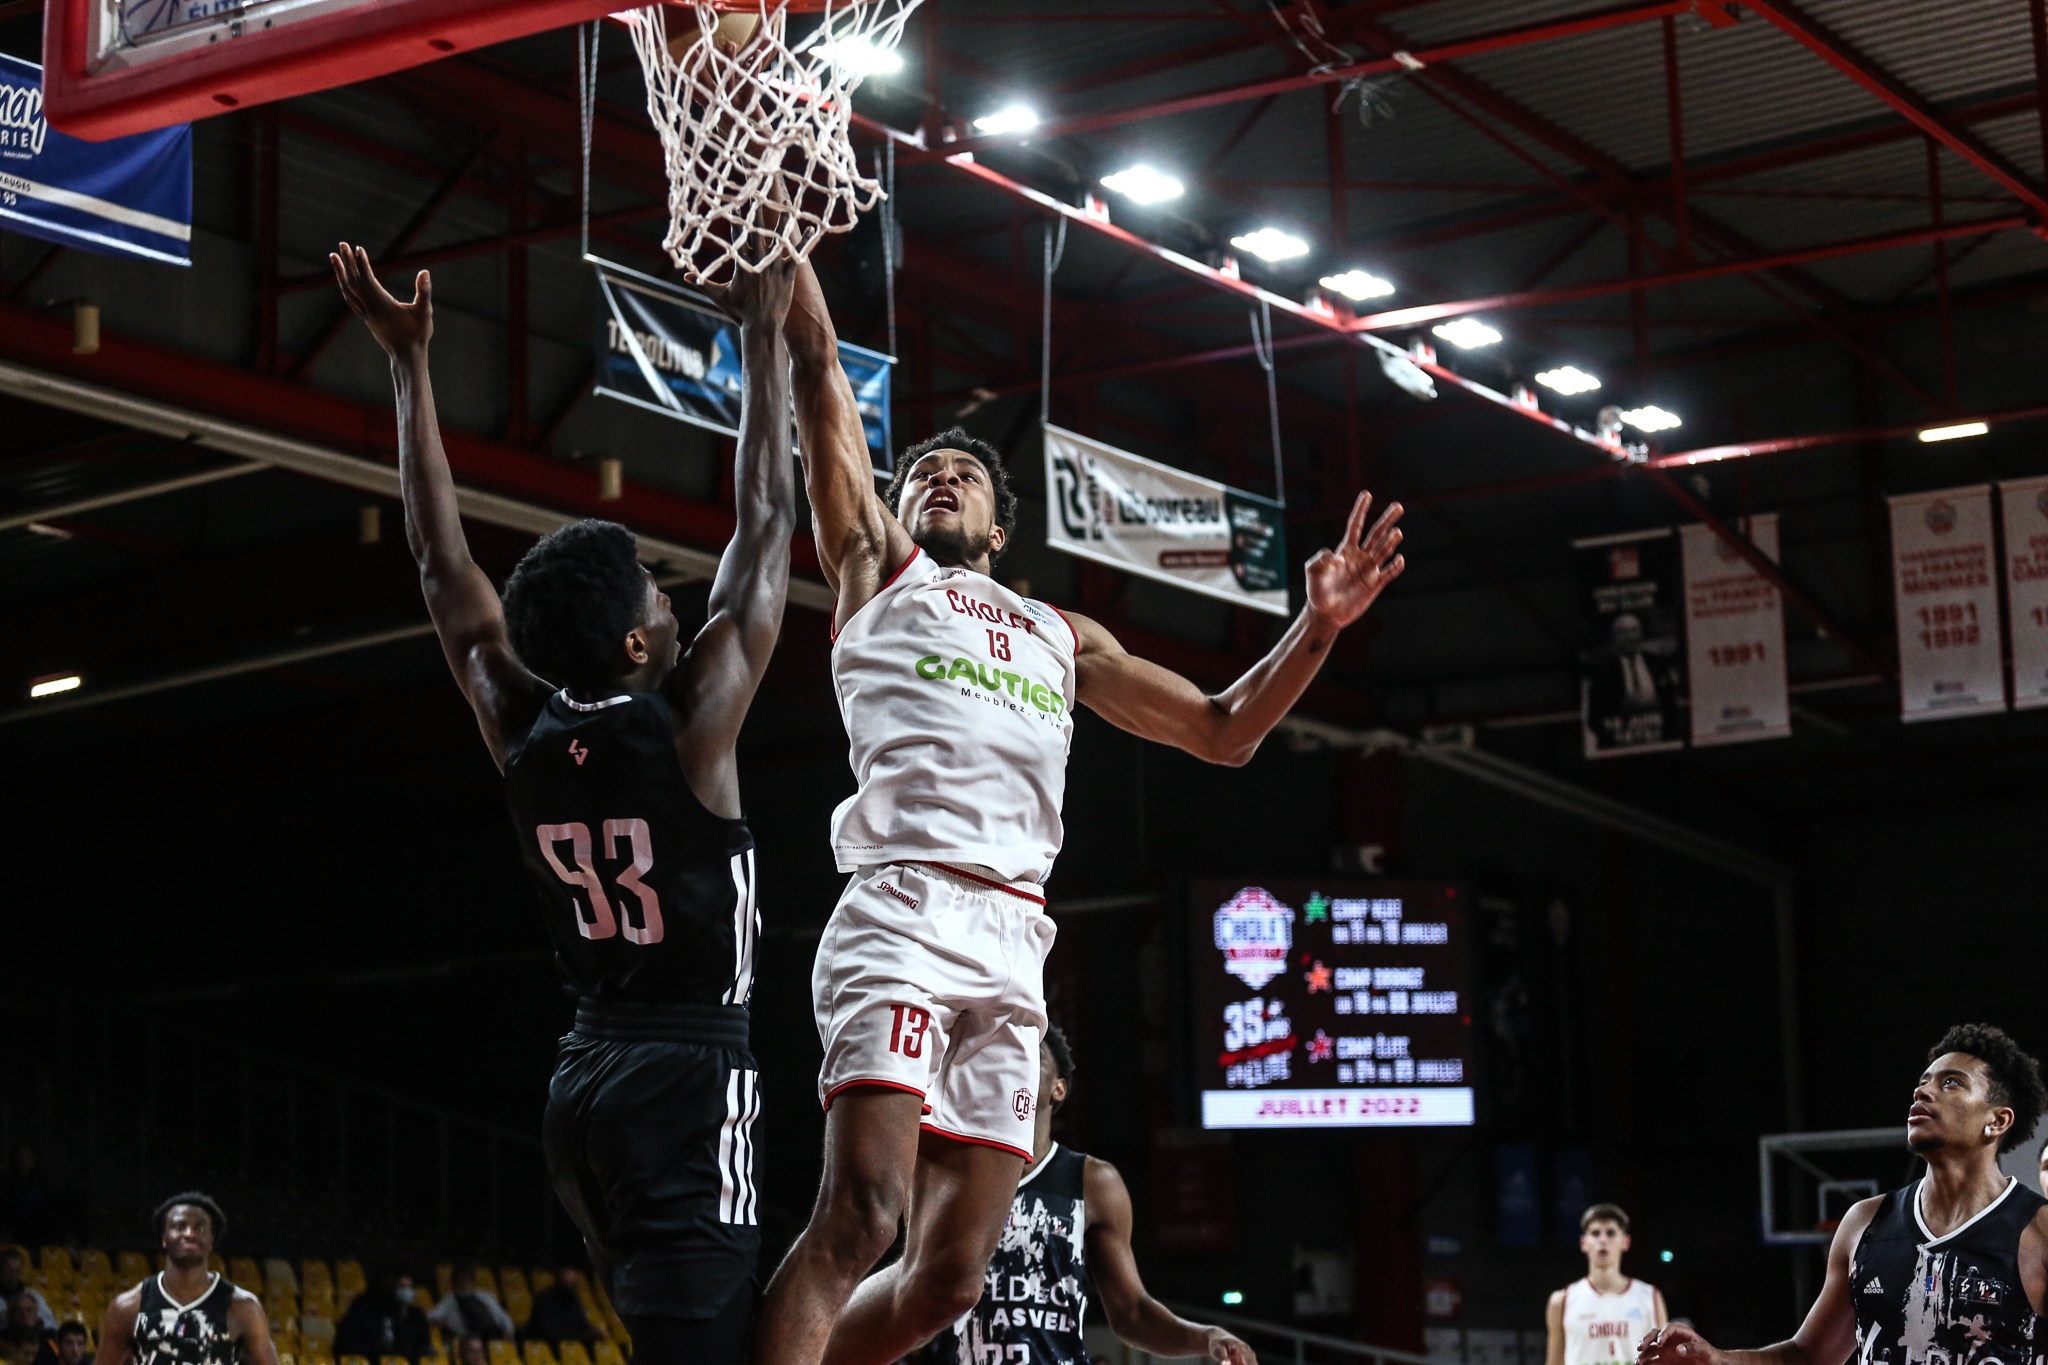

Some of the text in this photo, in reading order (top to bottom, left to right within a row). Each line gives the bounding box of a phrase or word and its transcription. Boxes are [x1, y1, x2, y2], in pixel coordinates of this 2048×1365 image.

[945, 588, 1037, 636] CHOLET
[1918, 602, 1978, 626] 1991
[986, 628, 1012, 662] 13
[536, 817, 664, 945] 93
[877, 881, 919, 910] SPALDING
[889, 1004, 930, 1059] 13
[1015, 1094, 1030, 1115] CB
[1257, 1098, 1420, 1117] JUILLET 2022
[992, 1307, 1071, 1333] ASVEL
